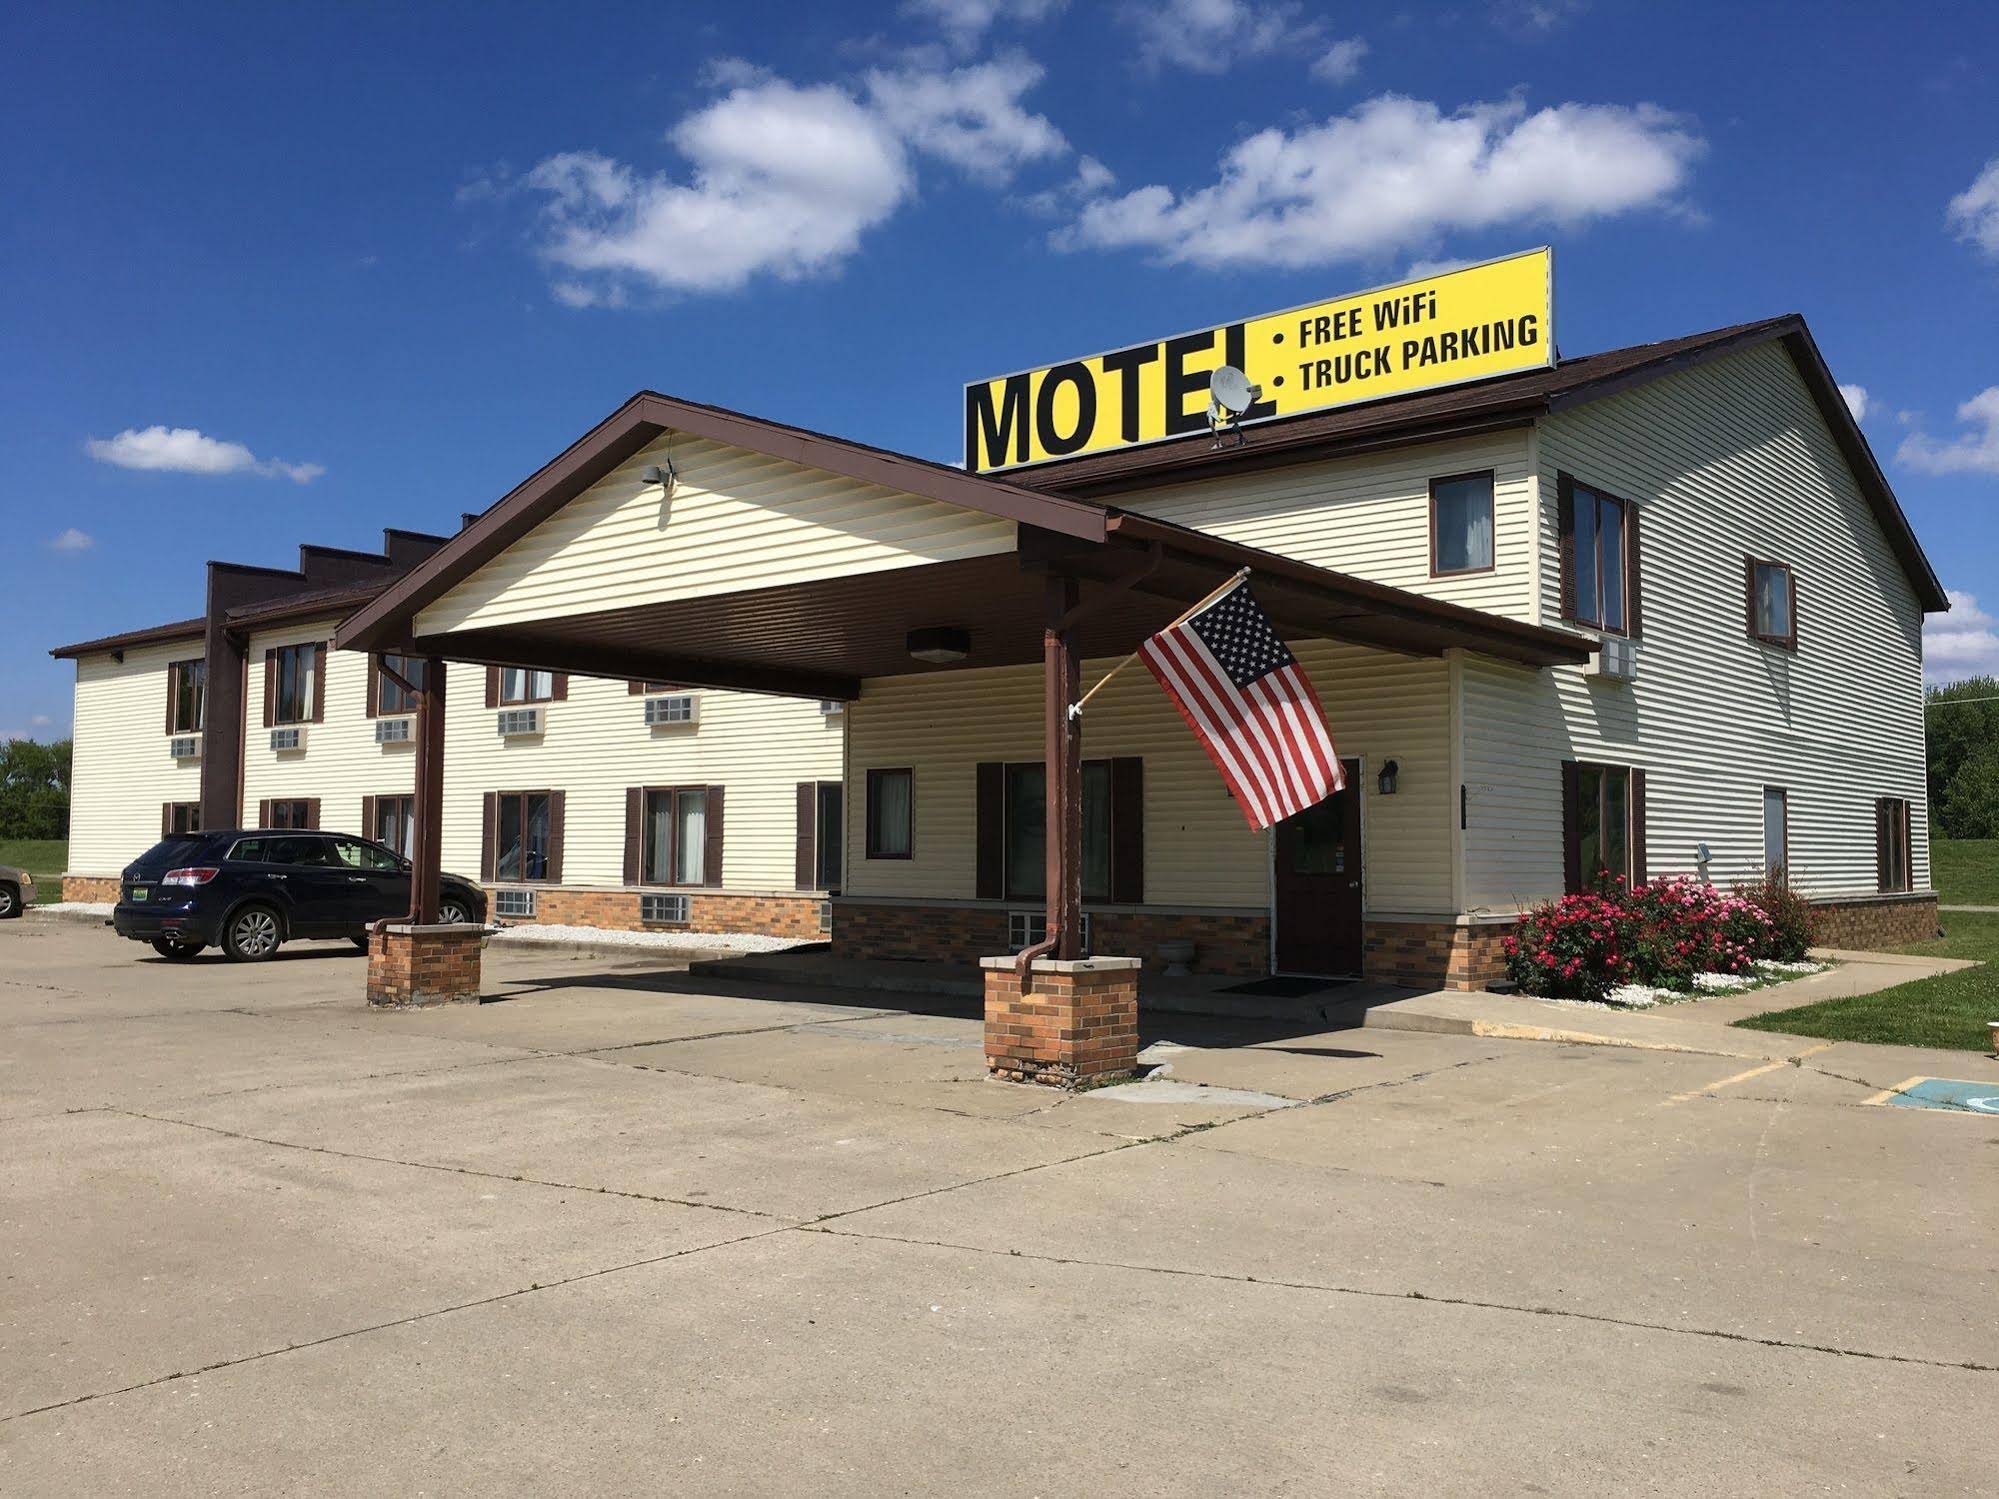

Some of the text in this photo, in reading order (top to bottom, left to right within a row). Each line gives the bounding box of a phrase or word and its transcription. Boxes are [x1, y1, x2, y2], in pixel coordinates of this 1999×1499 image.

[1300, 290, 1436, 348] FREE WiFi
[1300, 314, 1538, 390] TRUCK PARKING
[967, 323, 1276, 472] MOTEL
